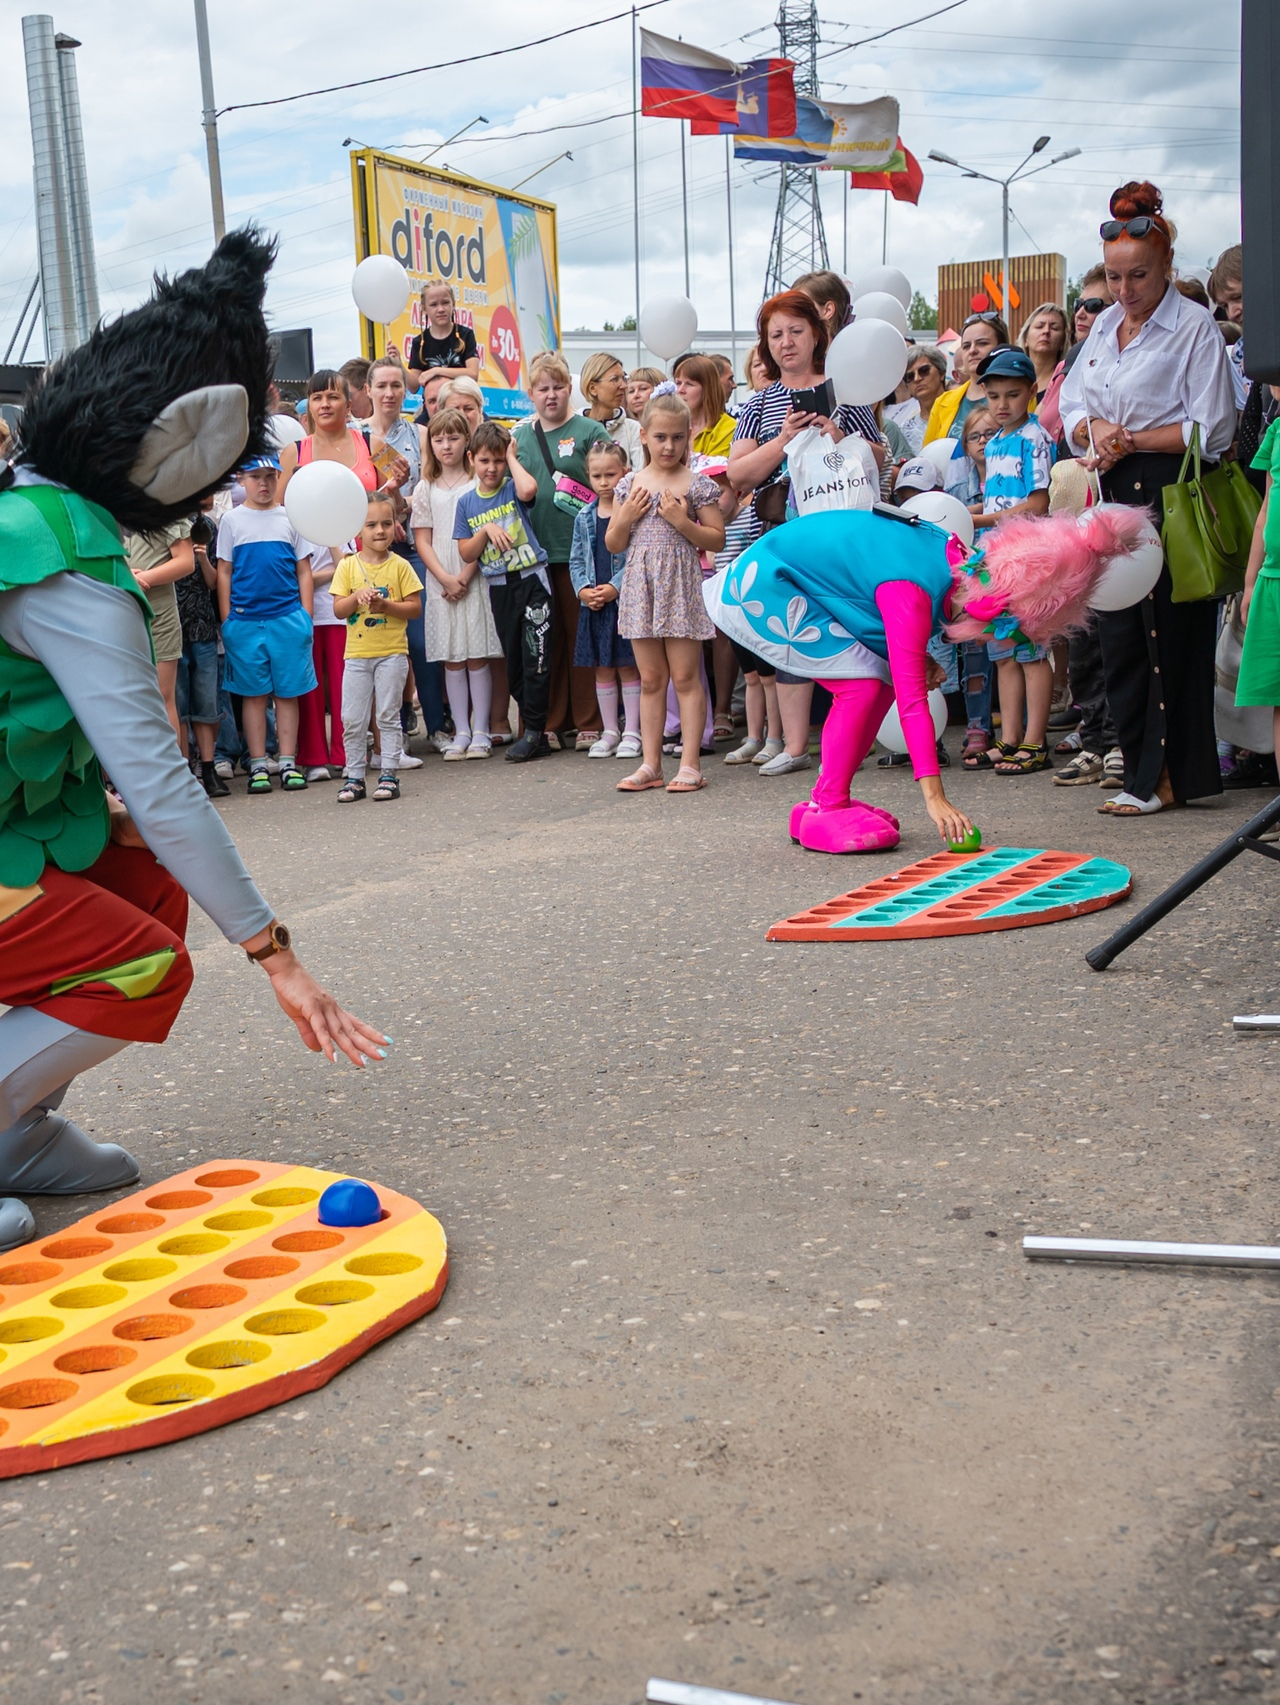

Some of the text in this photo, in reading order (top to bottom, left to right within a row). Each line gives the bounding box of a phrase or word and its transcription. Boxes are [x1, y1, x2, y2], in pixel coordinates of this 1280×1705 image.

[391, 207, 487, 286] diford
[570, 485, 592, 501] good
[802, 479, 845, 502] JEANS
[503, 543, 537, 572] 20
